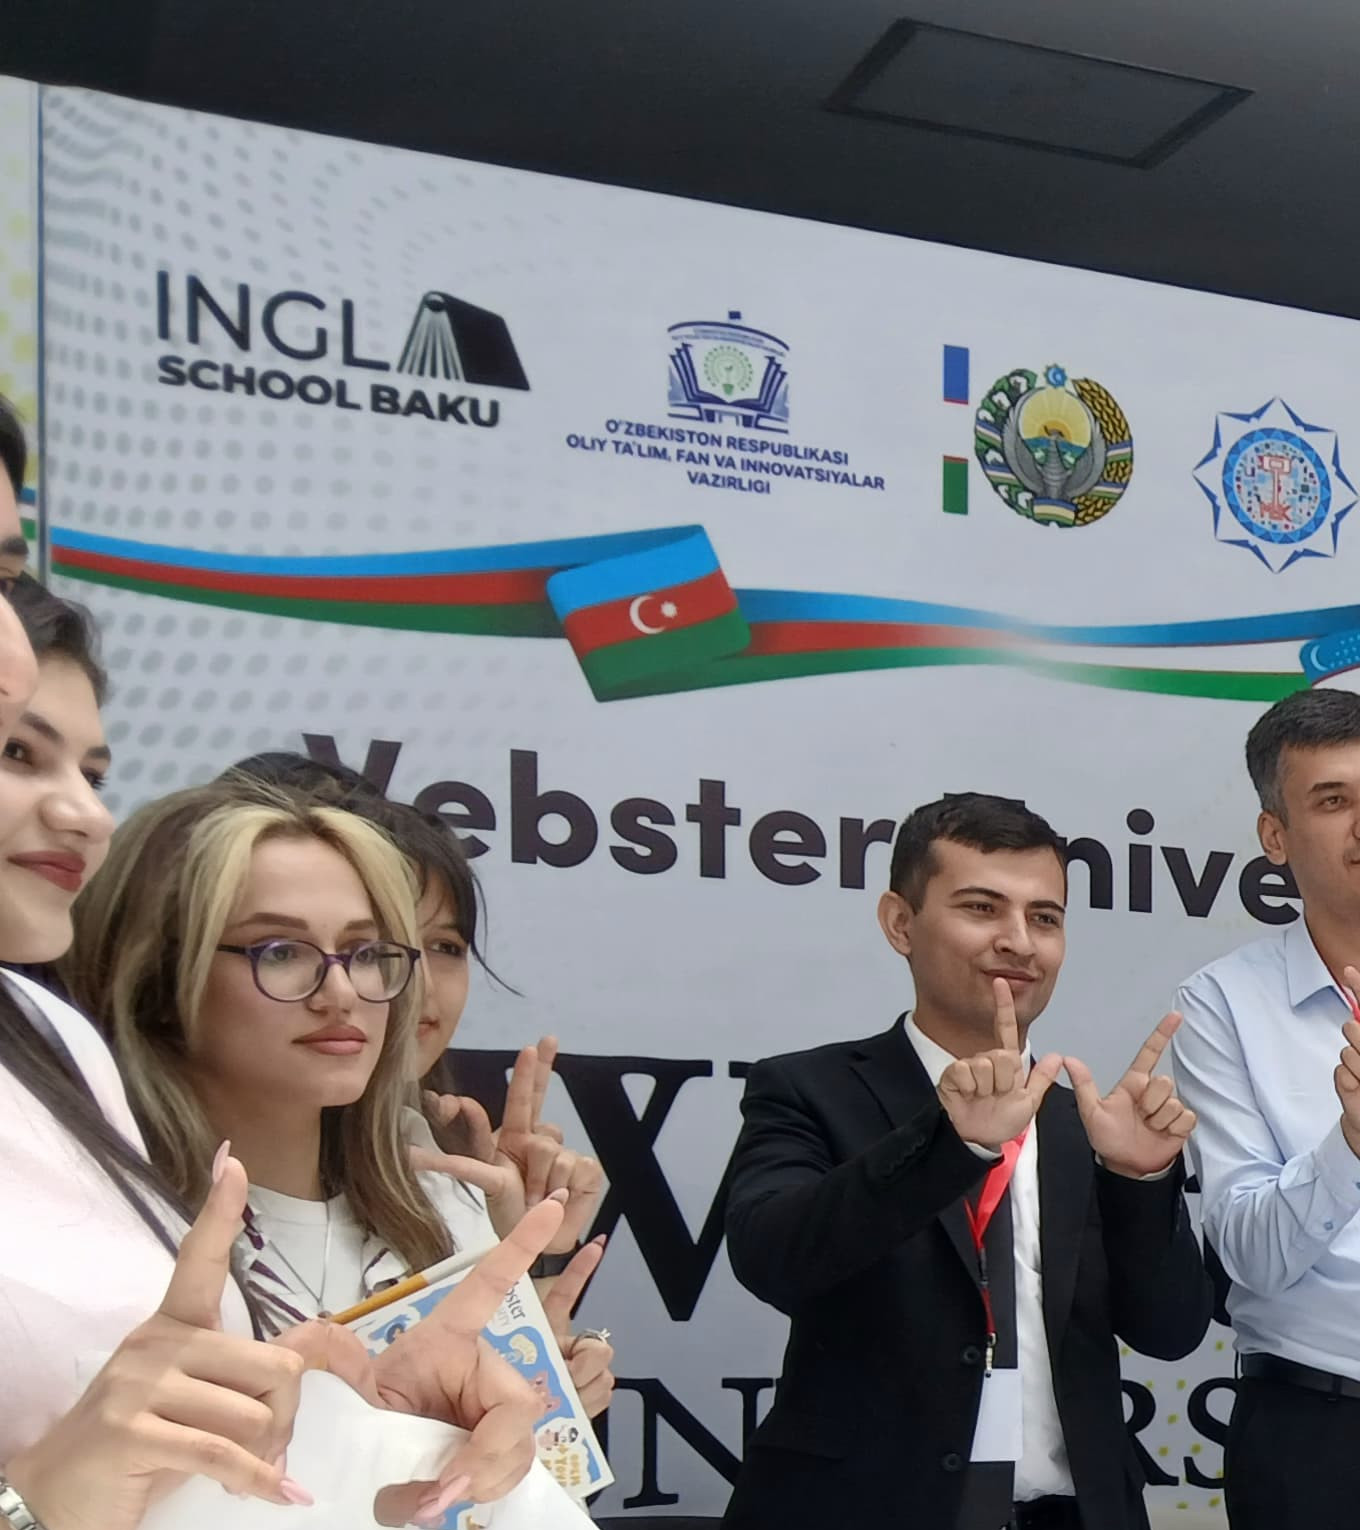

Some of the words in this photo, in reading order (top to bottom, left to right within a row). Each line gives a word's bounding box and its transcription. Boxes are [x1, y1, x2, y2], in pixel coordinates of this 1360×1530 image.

[157, 355, 363, 411] SCHOOL
[370, 396, 500, 428] BAKU
[565, 432, 609, 452] OLIY
[675, 449, 711, 468] FAN
[713, 454, 738, 472] VA
[740, 457, 886, 491] INNOVATSIYALAR
[726, 435, 850, 466] RESPUBLIKASI
[687, 470, 772, 495] VAZIRLIGI
